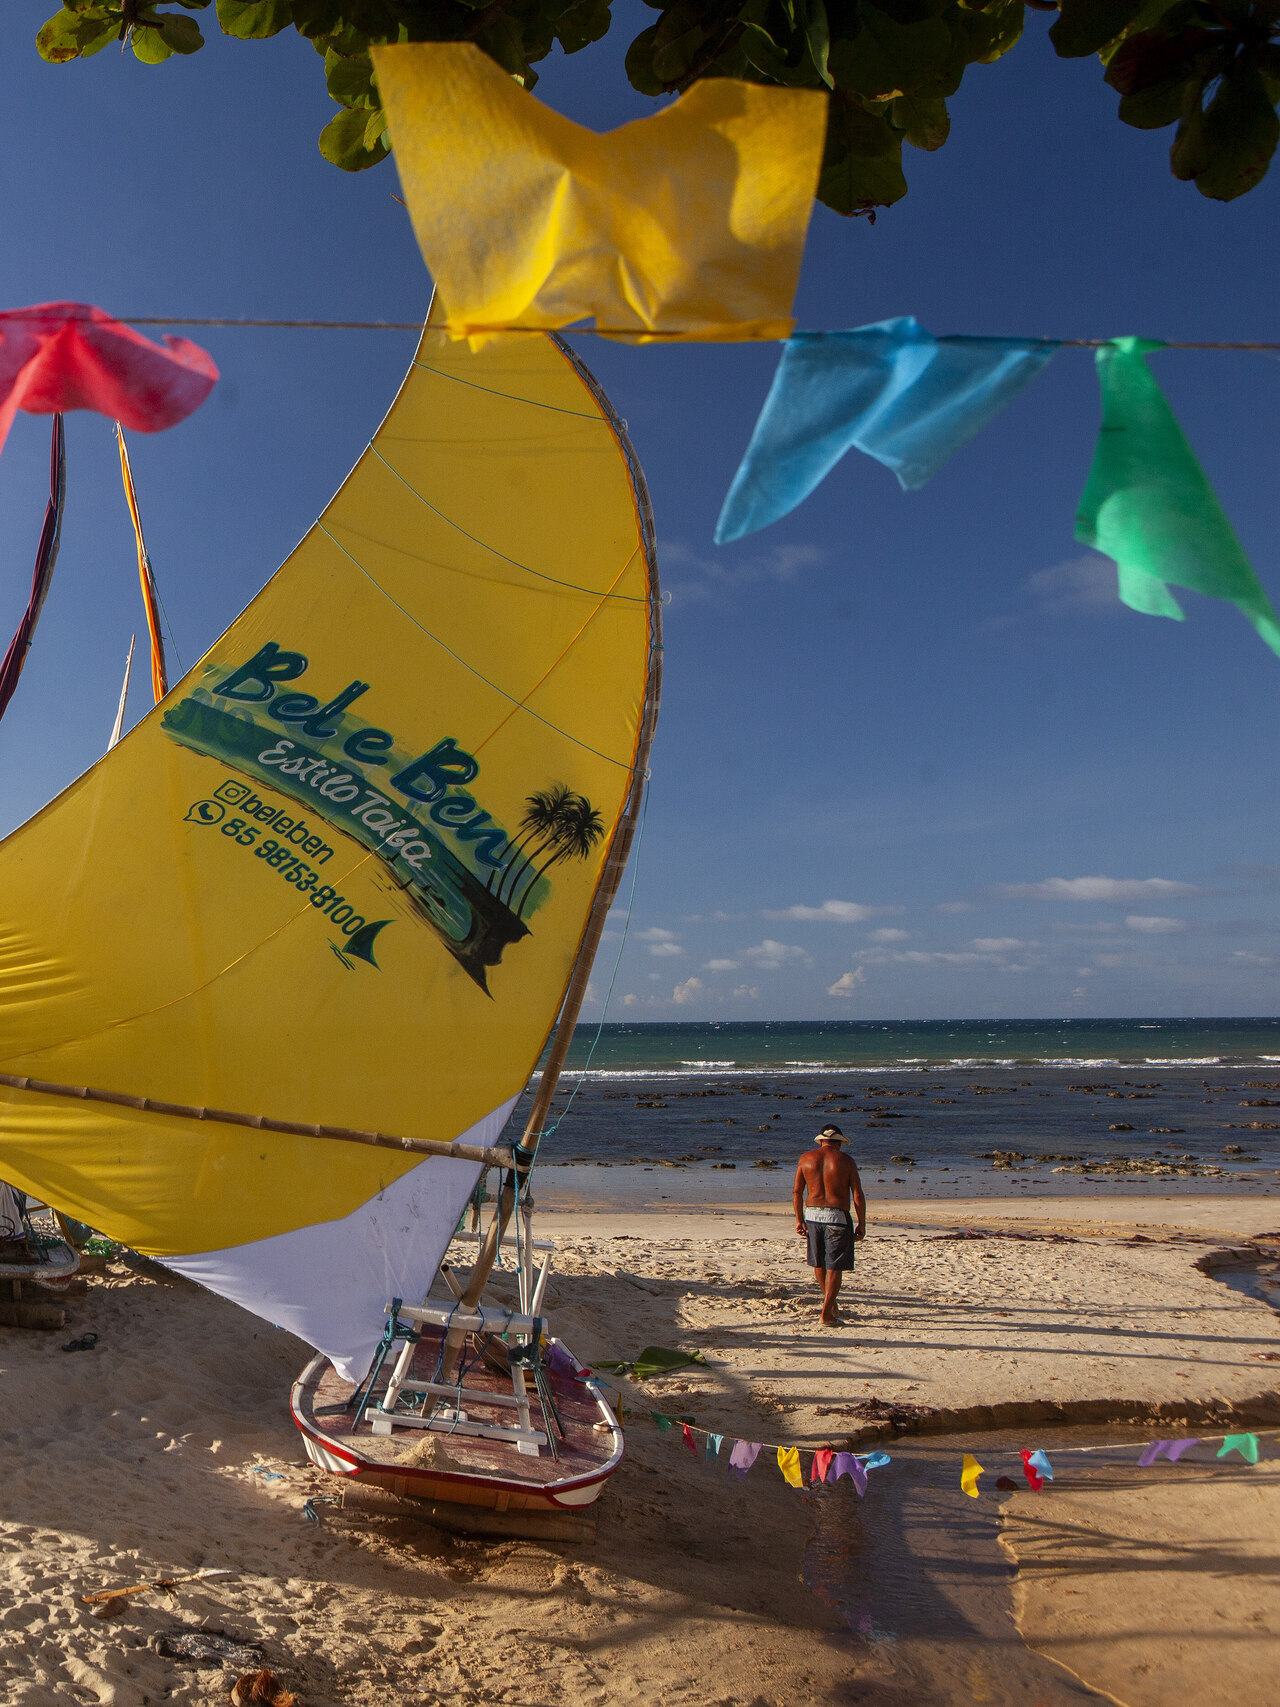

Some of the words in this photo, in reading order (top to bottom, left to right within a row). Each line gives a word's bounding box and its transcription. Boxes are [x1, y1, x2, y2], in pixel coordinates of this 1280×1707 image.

[212, 641, 370, 739] Bel
[342, 728, 394, 766] e
[389, 736, 509, 871] Ben
[258, 740, 360, 802] Estilo
[220, 818, 262, 846] 85
[253, 839, 366, 935] 98153-8100
[238, 794, 335, 865] beleben
